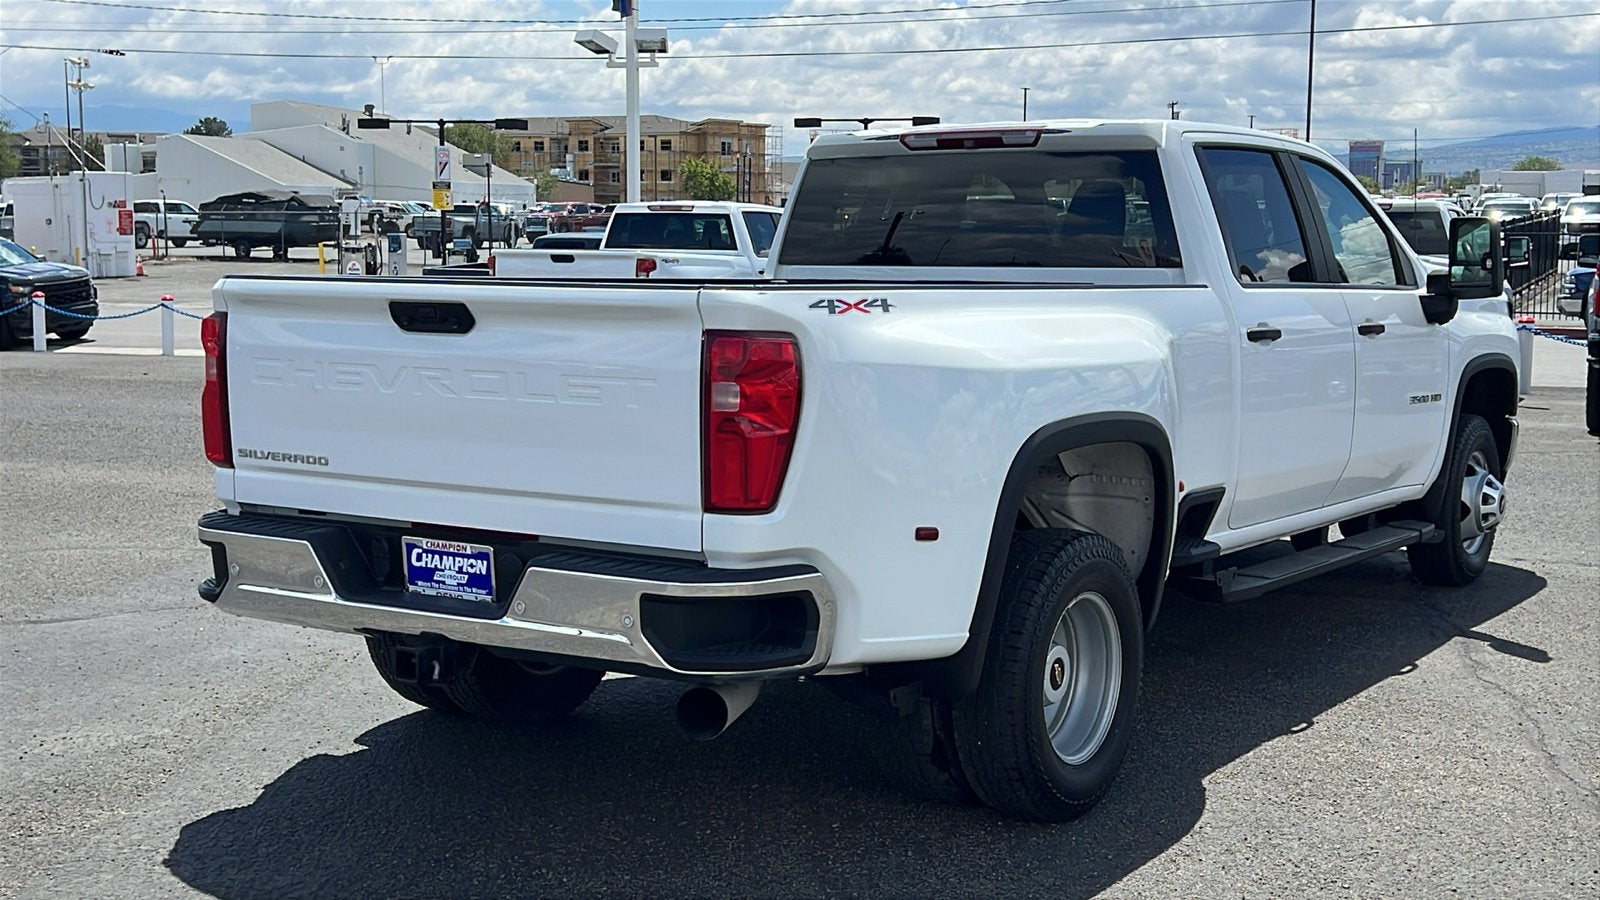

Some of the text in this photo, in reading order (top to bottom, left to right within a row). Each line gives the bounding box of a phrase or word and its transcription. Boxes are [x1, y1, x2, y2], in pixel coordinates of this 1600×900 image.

[250, 356, 657, 409] CHEVROLET
[237, 448, 330, 467] SILVERADO
[426, 541, 467, 552] CHAMPION
[411, 548, 487, 575] CHAMPION
[436, 573, 466, 582] CHEVROLET
